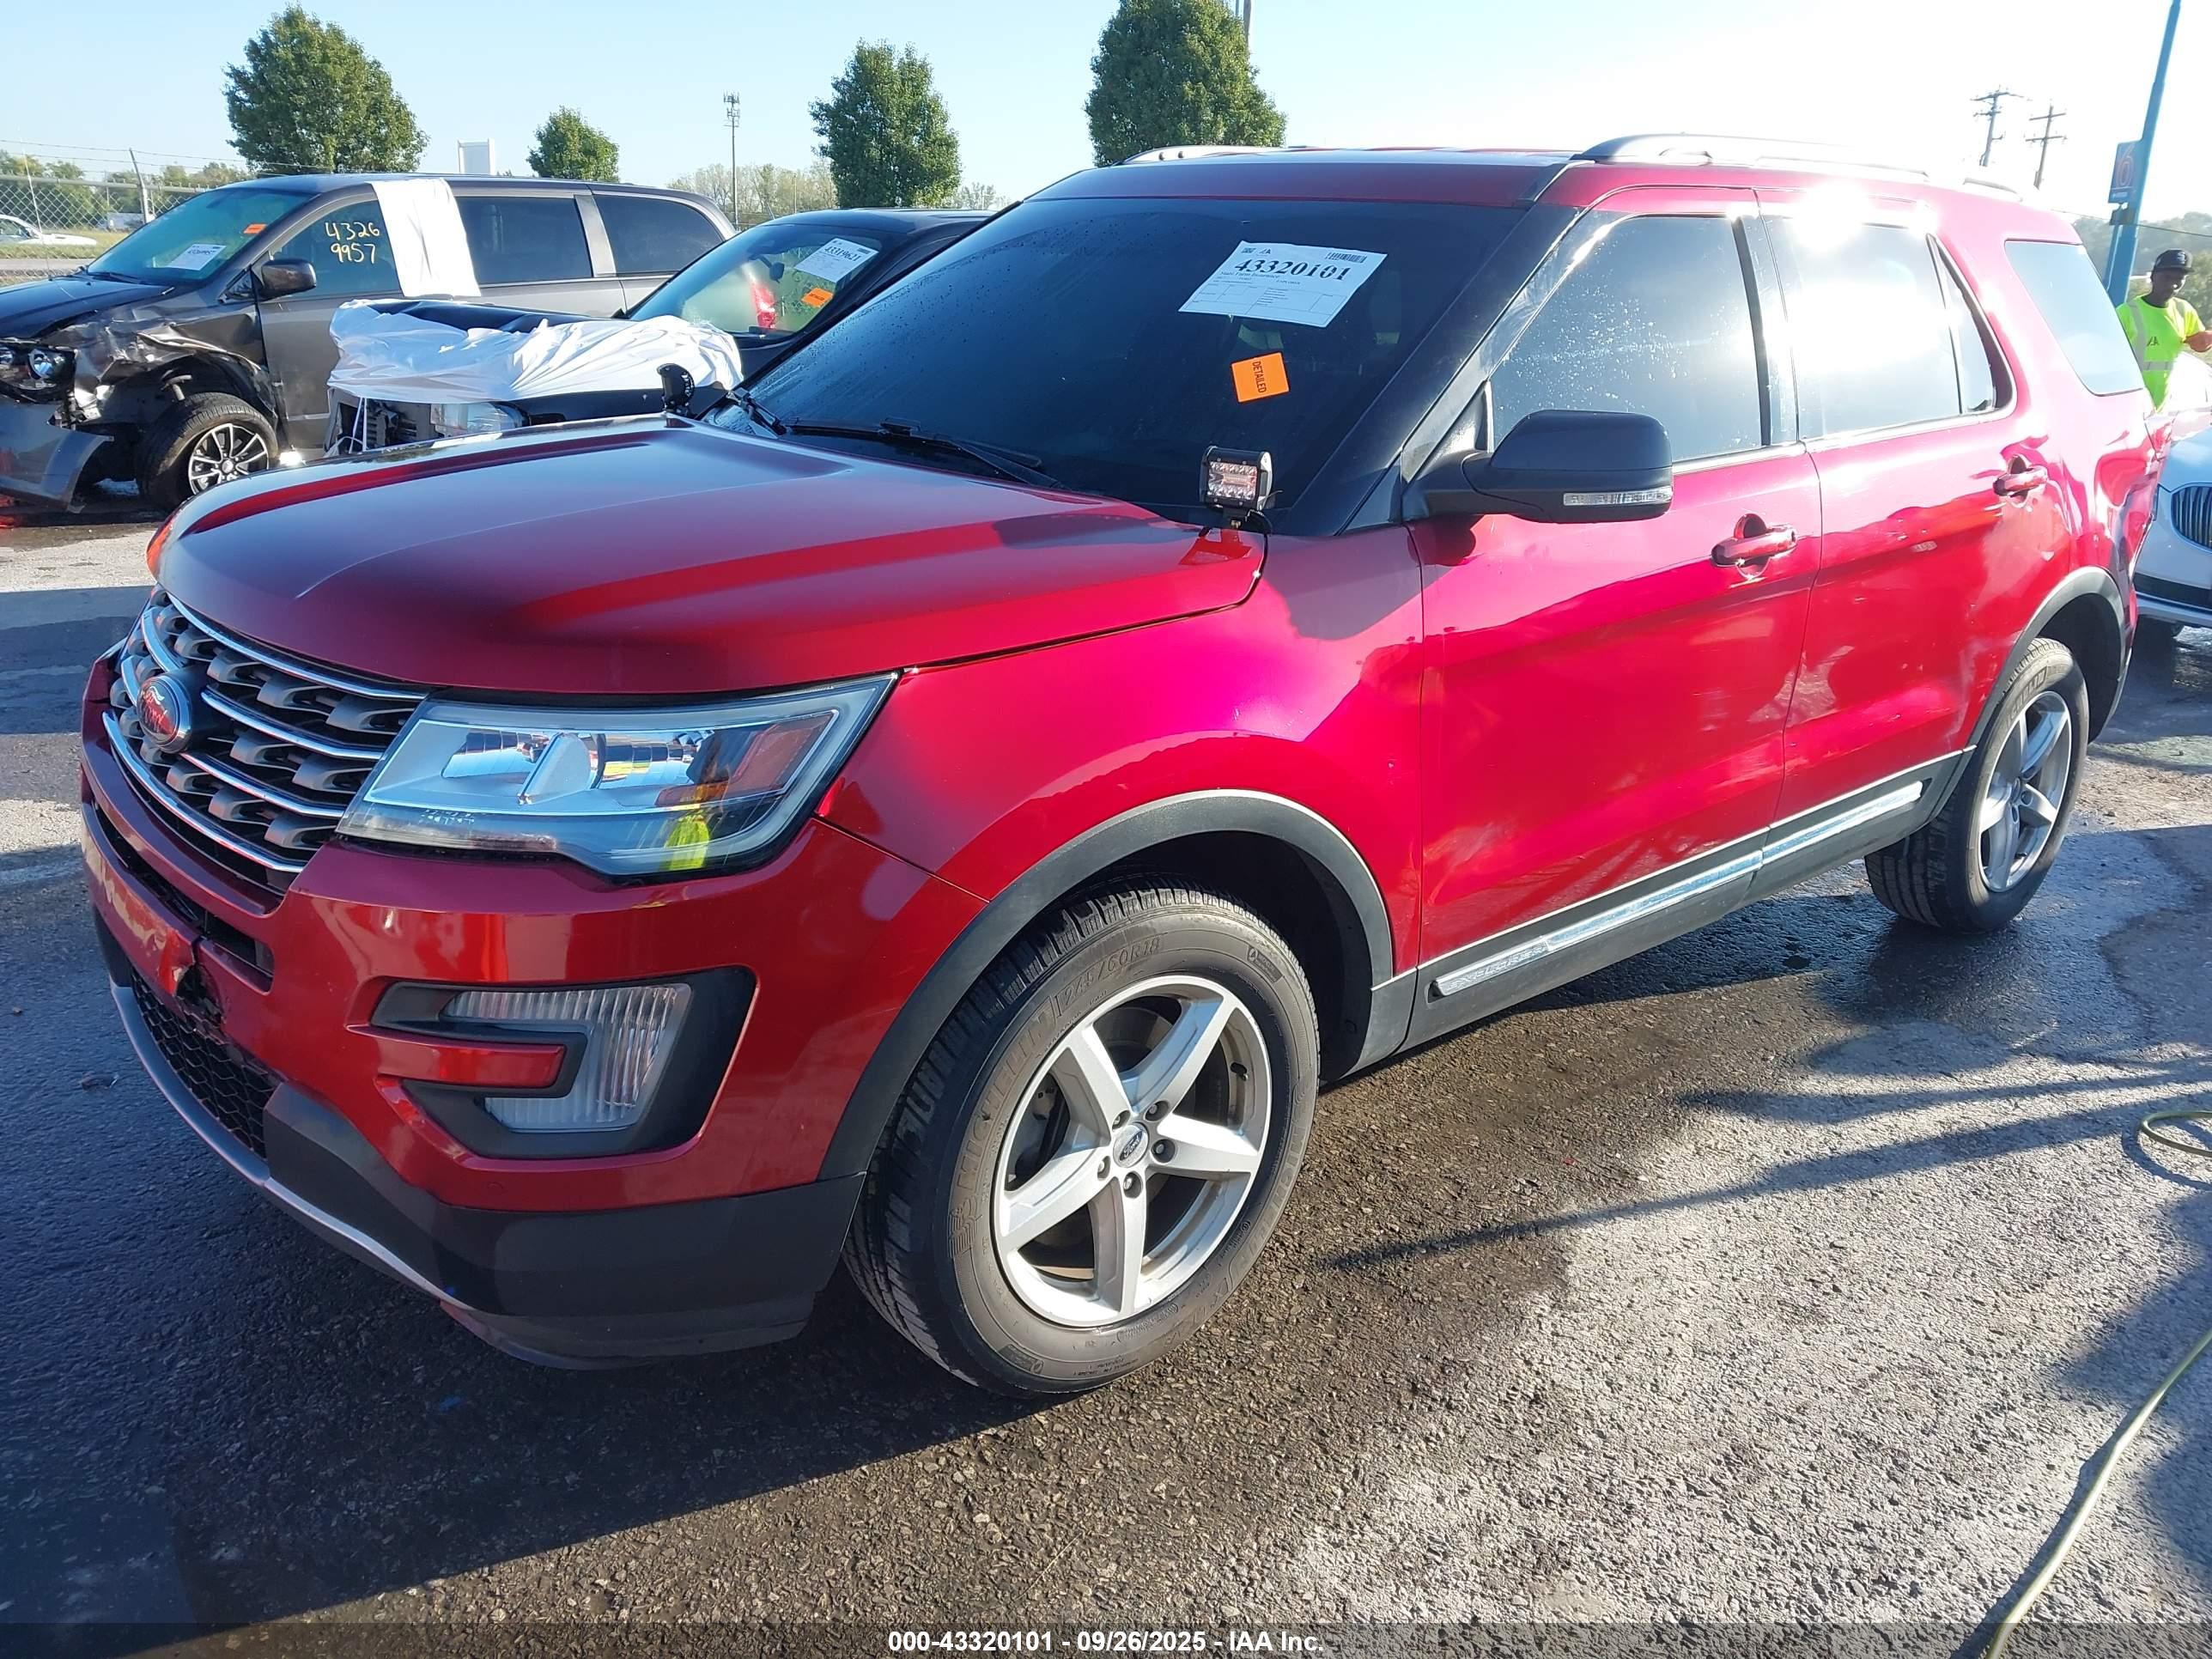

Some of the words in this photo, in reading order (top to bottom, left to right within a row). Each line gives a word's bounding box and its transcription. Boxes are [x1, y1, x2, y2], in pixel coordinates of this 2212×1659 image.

[325, 222, 380, 240] 4326
[330, 242, 376, 264] 9957
[1235, 258, 1351, 281] 43320101
[1252, 361, 1267, 393] DETAILED
[957, 1003, 1054, 1191] MICHELIN
